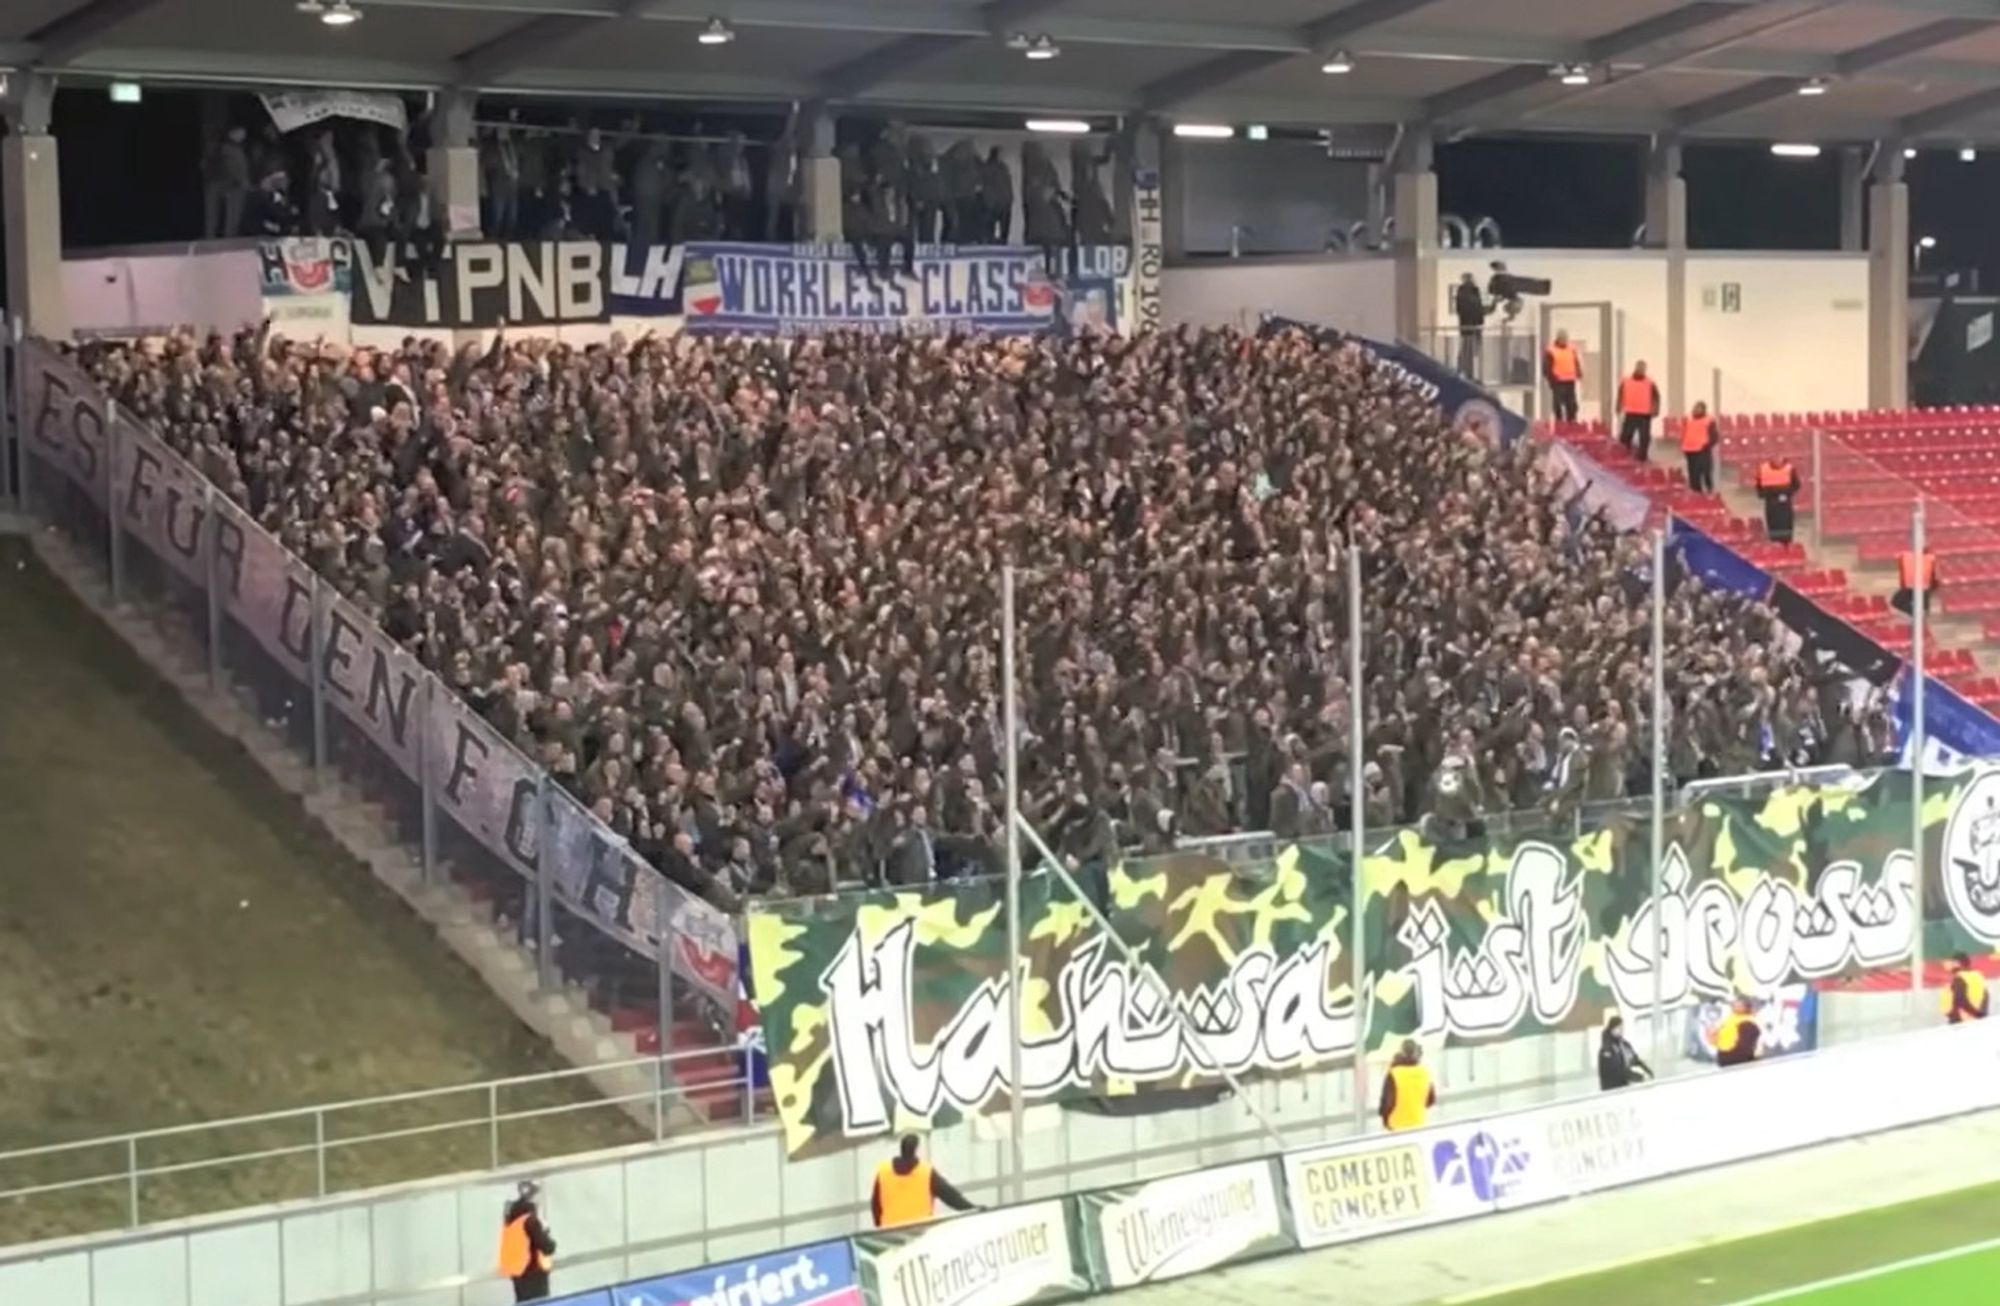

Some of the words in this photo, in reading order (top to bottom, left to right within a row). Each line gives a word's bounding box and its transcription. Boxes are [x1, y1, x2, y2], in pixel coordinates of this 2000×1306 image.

[611, 244, 686, 299] LH
[716, 257, 908, 317] WORKLESS
[922, 261, 1027, 316] CLASS
[1141, 286, 1161, 336] 196
[35, 370, 105, 483] ES
[126, 445, 247, 600] FÜR
[277, 576, 418, 748] DEN
[819, 915, 1374, 1137] Hansa
[1397, 841, 1590, 1039] ist
[1305, 1151, 1418, 1196] COMEDIA
[1312, 1183, 1423, 1229] CONCEPT
